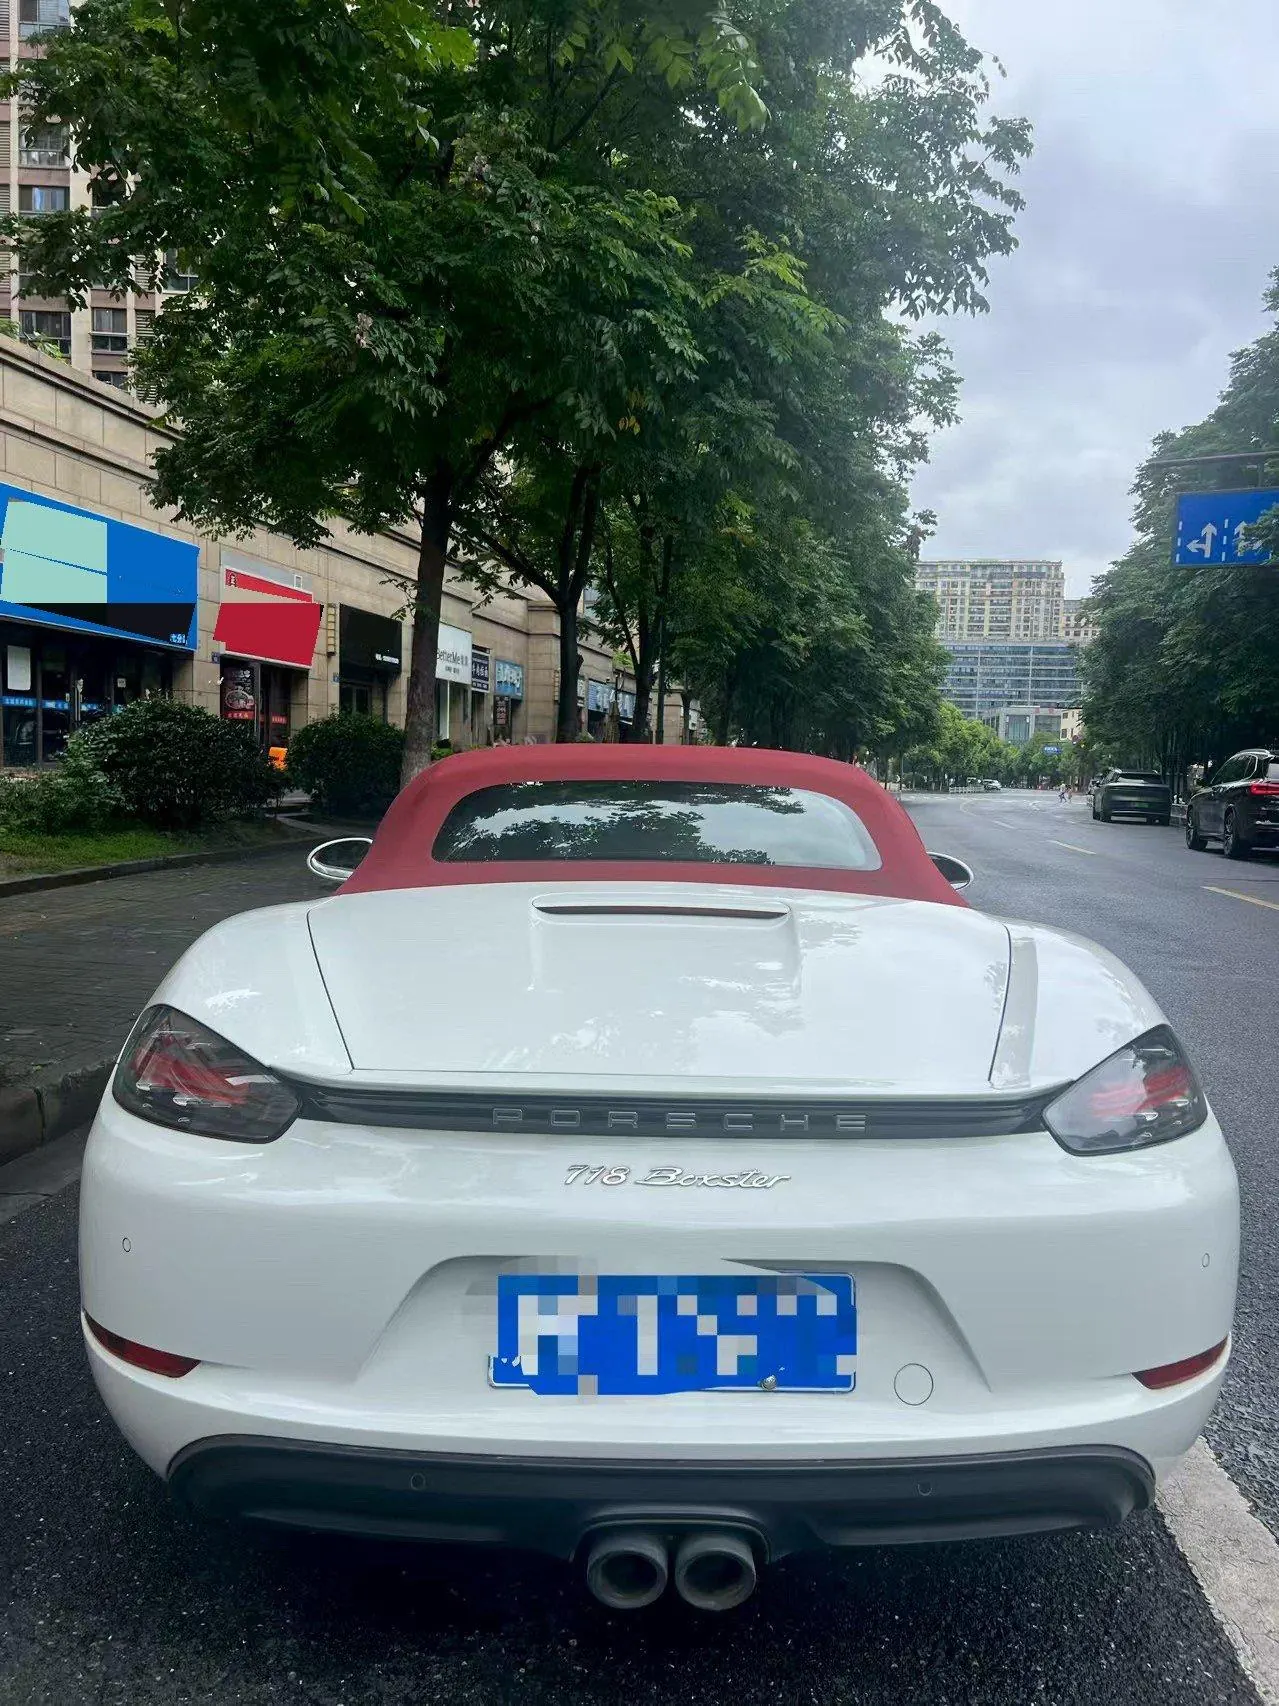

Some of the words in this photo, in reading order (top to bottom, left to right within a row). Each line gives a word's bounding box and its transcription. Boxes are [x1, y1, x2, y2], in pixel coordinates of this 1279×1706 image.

[492, 1108, 867, 1131] PORSCHE
[564, 1164, 630, 1186] 718
[635, 1165, 792, 1189] Boxster
